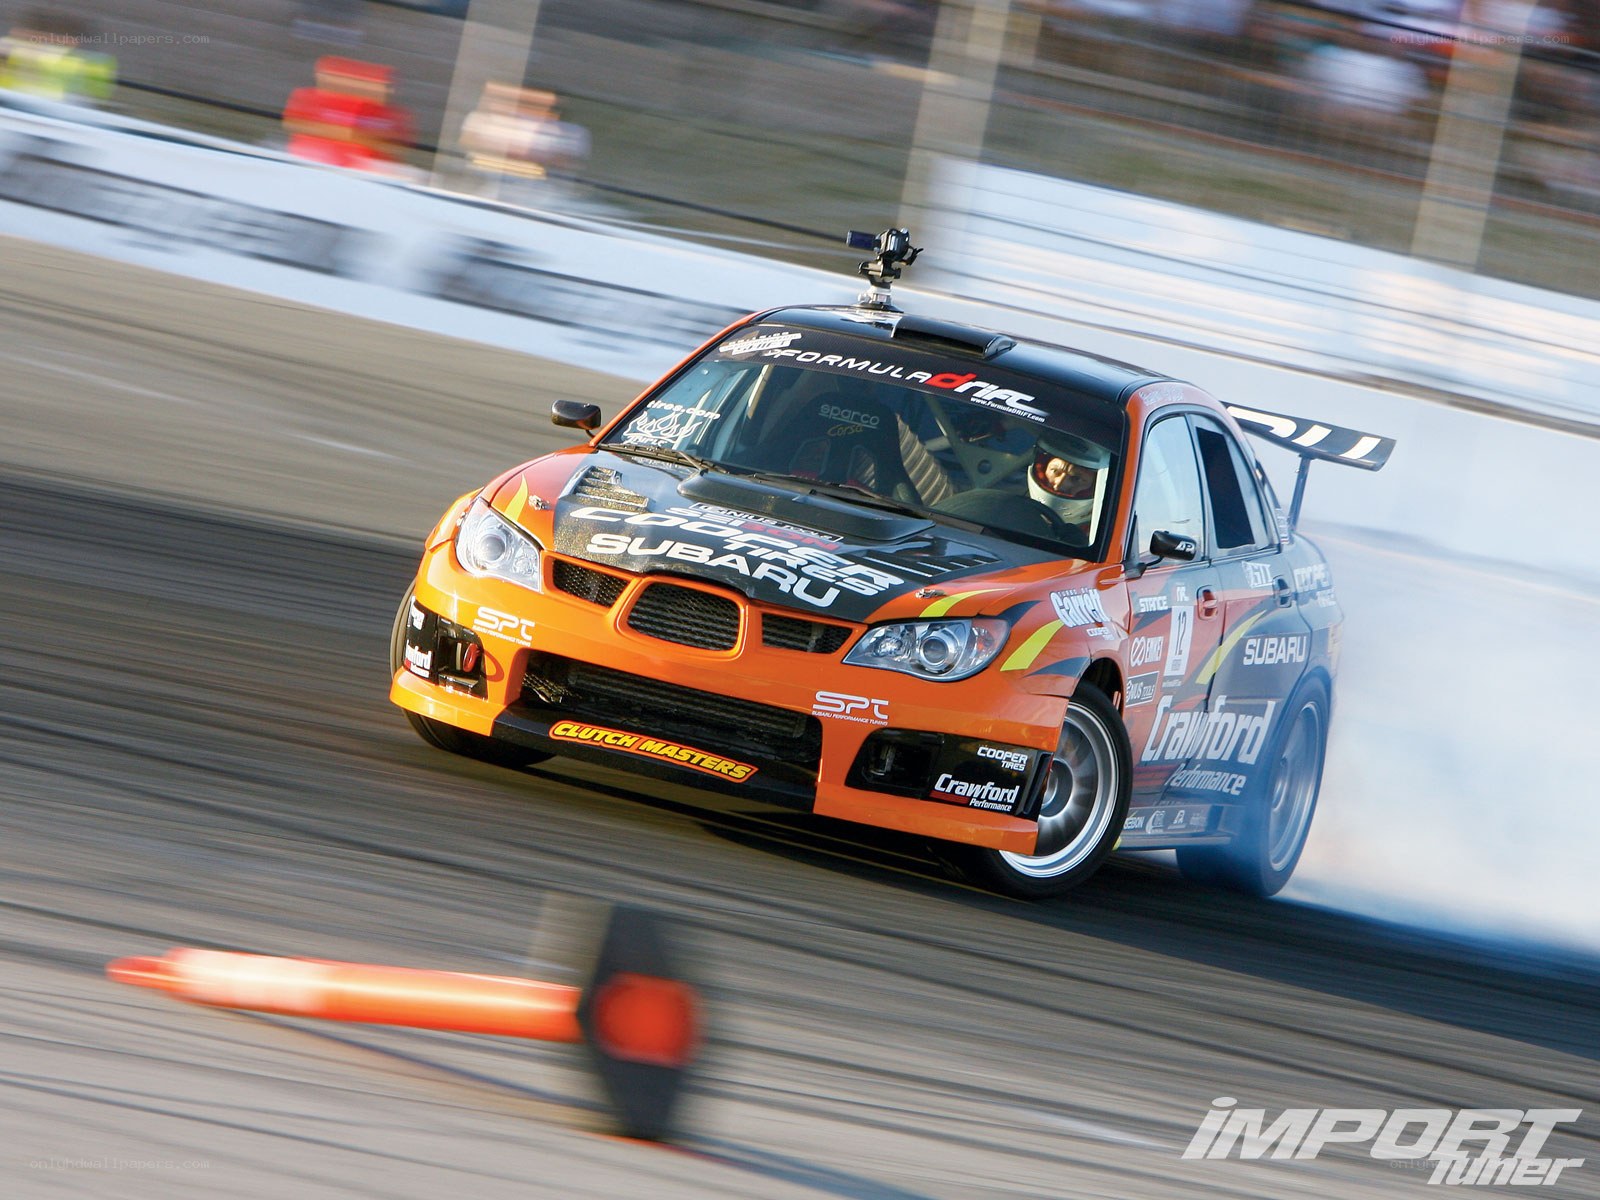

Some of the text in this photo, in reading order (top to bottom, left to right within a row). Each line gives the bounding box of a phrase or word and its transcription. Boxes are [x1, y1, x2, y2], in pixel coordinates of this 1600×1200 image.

[774, 348, 934, 384] FORMULA
[569, 505, 905, 590] COOPER
[586, 533, 841, 608] SUBARU
[725, 540, 888, 597] TIRES
[1242, 636, 1307, 666] SUBARU
[1141, 694, 1276, 766] Crawford
[552, 722, 752, 779] CLUTCH MASTERS
[976, 745, 1028, 765] COOPER
[1001, 759, 1027, 772] TIRES
[934, 773, 1020, 804] Crawford
[1164, 762, 1247, 796] Performance
[969, 797, 1013, 813] Performance
